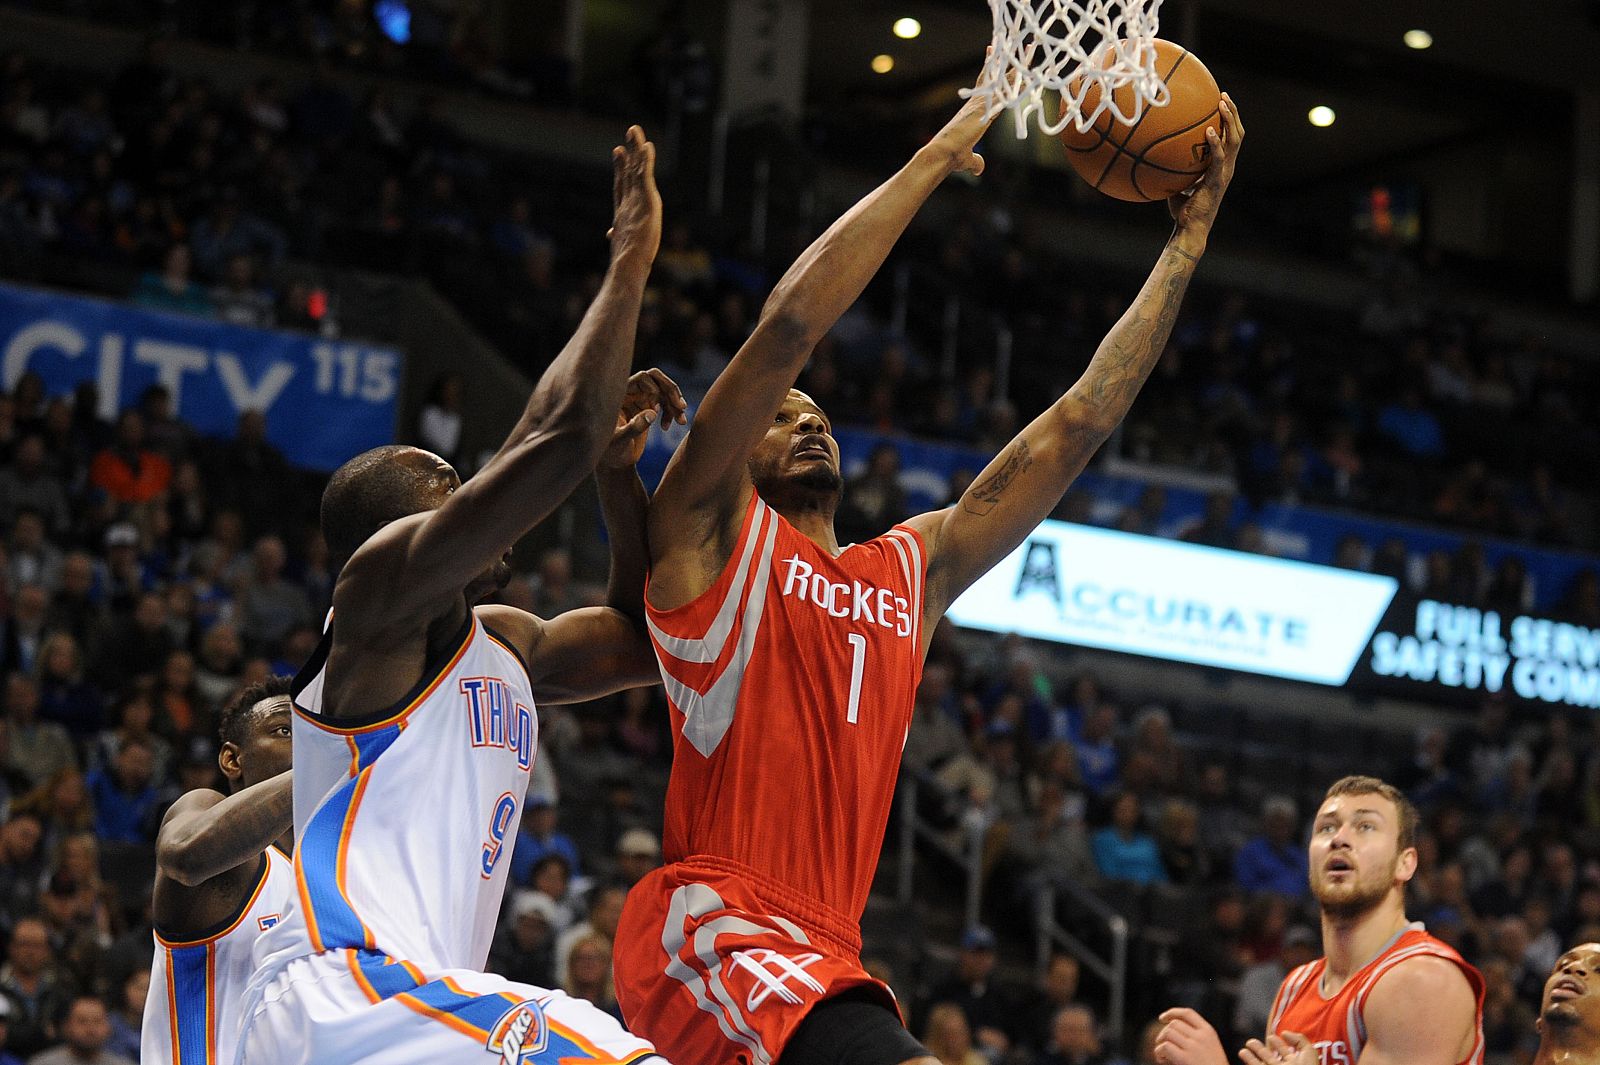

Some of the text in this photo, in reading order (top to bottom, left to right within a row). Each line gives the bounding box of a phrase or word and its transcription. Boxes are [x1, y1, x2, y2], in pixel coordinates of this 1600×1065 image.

[3, 320, 296, 424] CITY
[312, 343, 397, 402] 115
[1014, 540, 1310, 649] ACCURATE
[1416, 600, 1507, 652] FULL
[847, 633, 866, 724] 1
[1372, 631, 1510, 693] SAFETY
[481, 791, 518, 879] 9
